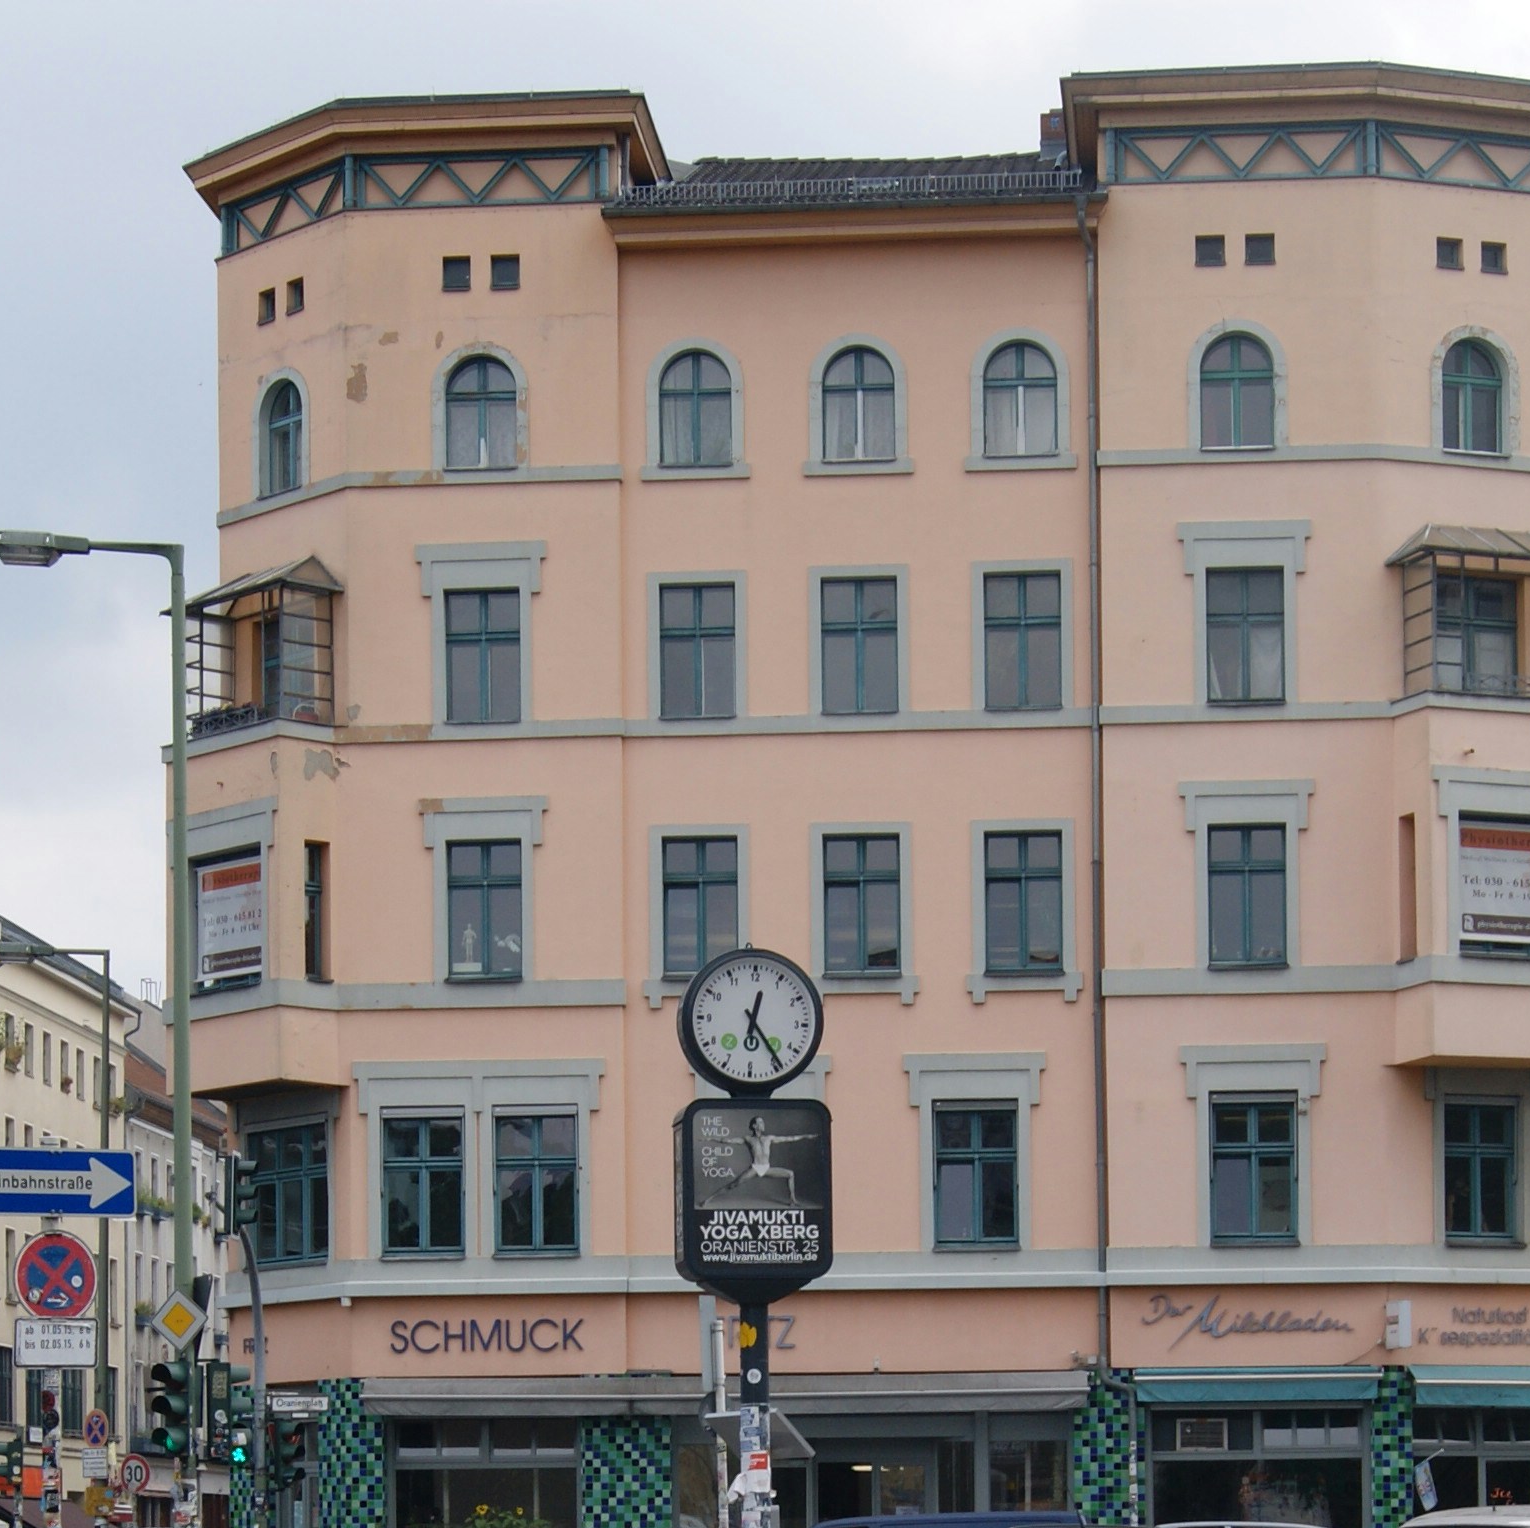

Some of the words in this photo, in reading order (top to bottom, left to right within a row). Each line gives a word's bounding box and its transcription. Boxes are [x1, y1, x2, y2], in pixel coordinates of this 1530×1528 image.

[1484, 877, 1503, 886] 030
[1512, 879, 1530, 888] 615
[729, 977, 738, 986] 11
[750, 973, 760, 982] 12
[775, 980, 780, 990] 1
[712, 992, 722, 1001] 10
[789, 998, 795, 1007] 2
[706, 1013, 712, 1022] 9
[794, 1020, 799, 1029] 3
[711, 1036, 716, 1045] 8
[786, 1042, 793, 1050] 4
[726, 1054, 732, 1063] 7
[747, 1061, 753, 1070] 6
[701, 1116, 722, 1126] THE
[701, 1127, 730, 1136] WILD
[701, 1147, 733, 1157] CHILD
[701, 1157, 717, 1167] OF
[701, 1167, 735, 1178] YOGA
[709, 1210, 805, 1225] JIVAMUKTI
[700, 1225, 753, 1240] YOGA
[757, 1225, 819, 1239] XBERG
[700, 1240, 799, 1253] ORANIENSTR.
[802, 1240, 819, 1253] 25
[702, 1252, 818, 1263] www.jivamuktiberlin.de
[1452, 1306, 1529, 1325] Naturkost
[1168, 1295, 1355, 1352] Milchladen
[390, 1318, 584, 1354] SCHMUCK
[24, 1340, 36, 1350] bis
[125, 1465, 143, 1483] 30
